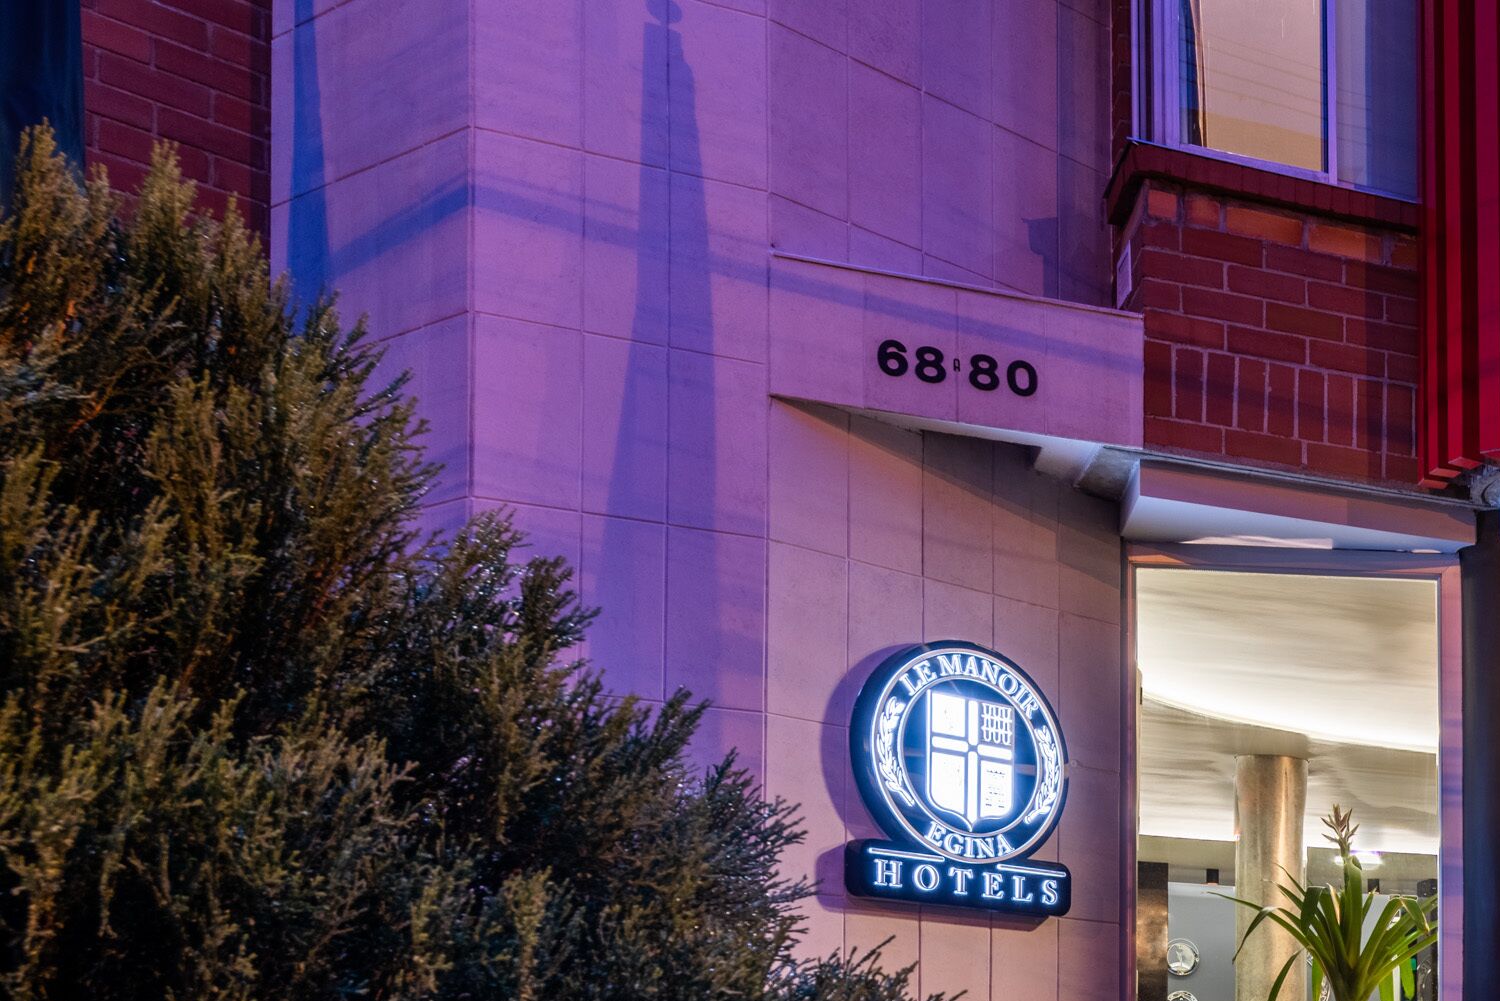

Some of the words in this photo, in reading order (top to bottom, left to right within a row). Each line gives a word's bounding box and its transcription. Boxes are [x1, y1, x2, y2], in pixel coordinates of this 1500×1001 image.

[899, 659, 937, 697] LE
[937, 653, 1040, 720] MANOIR
[923, 820, 1016, 860] EGINA
[873, 858, 1059, 905] HOTELS
